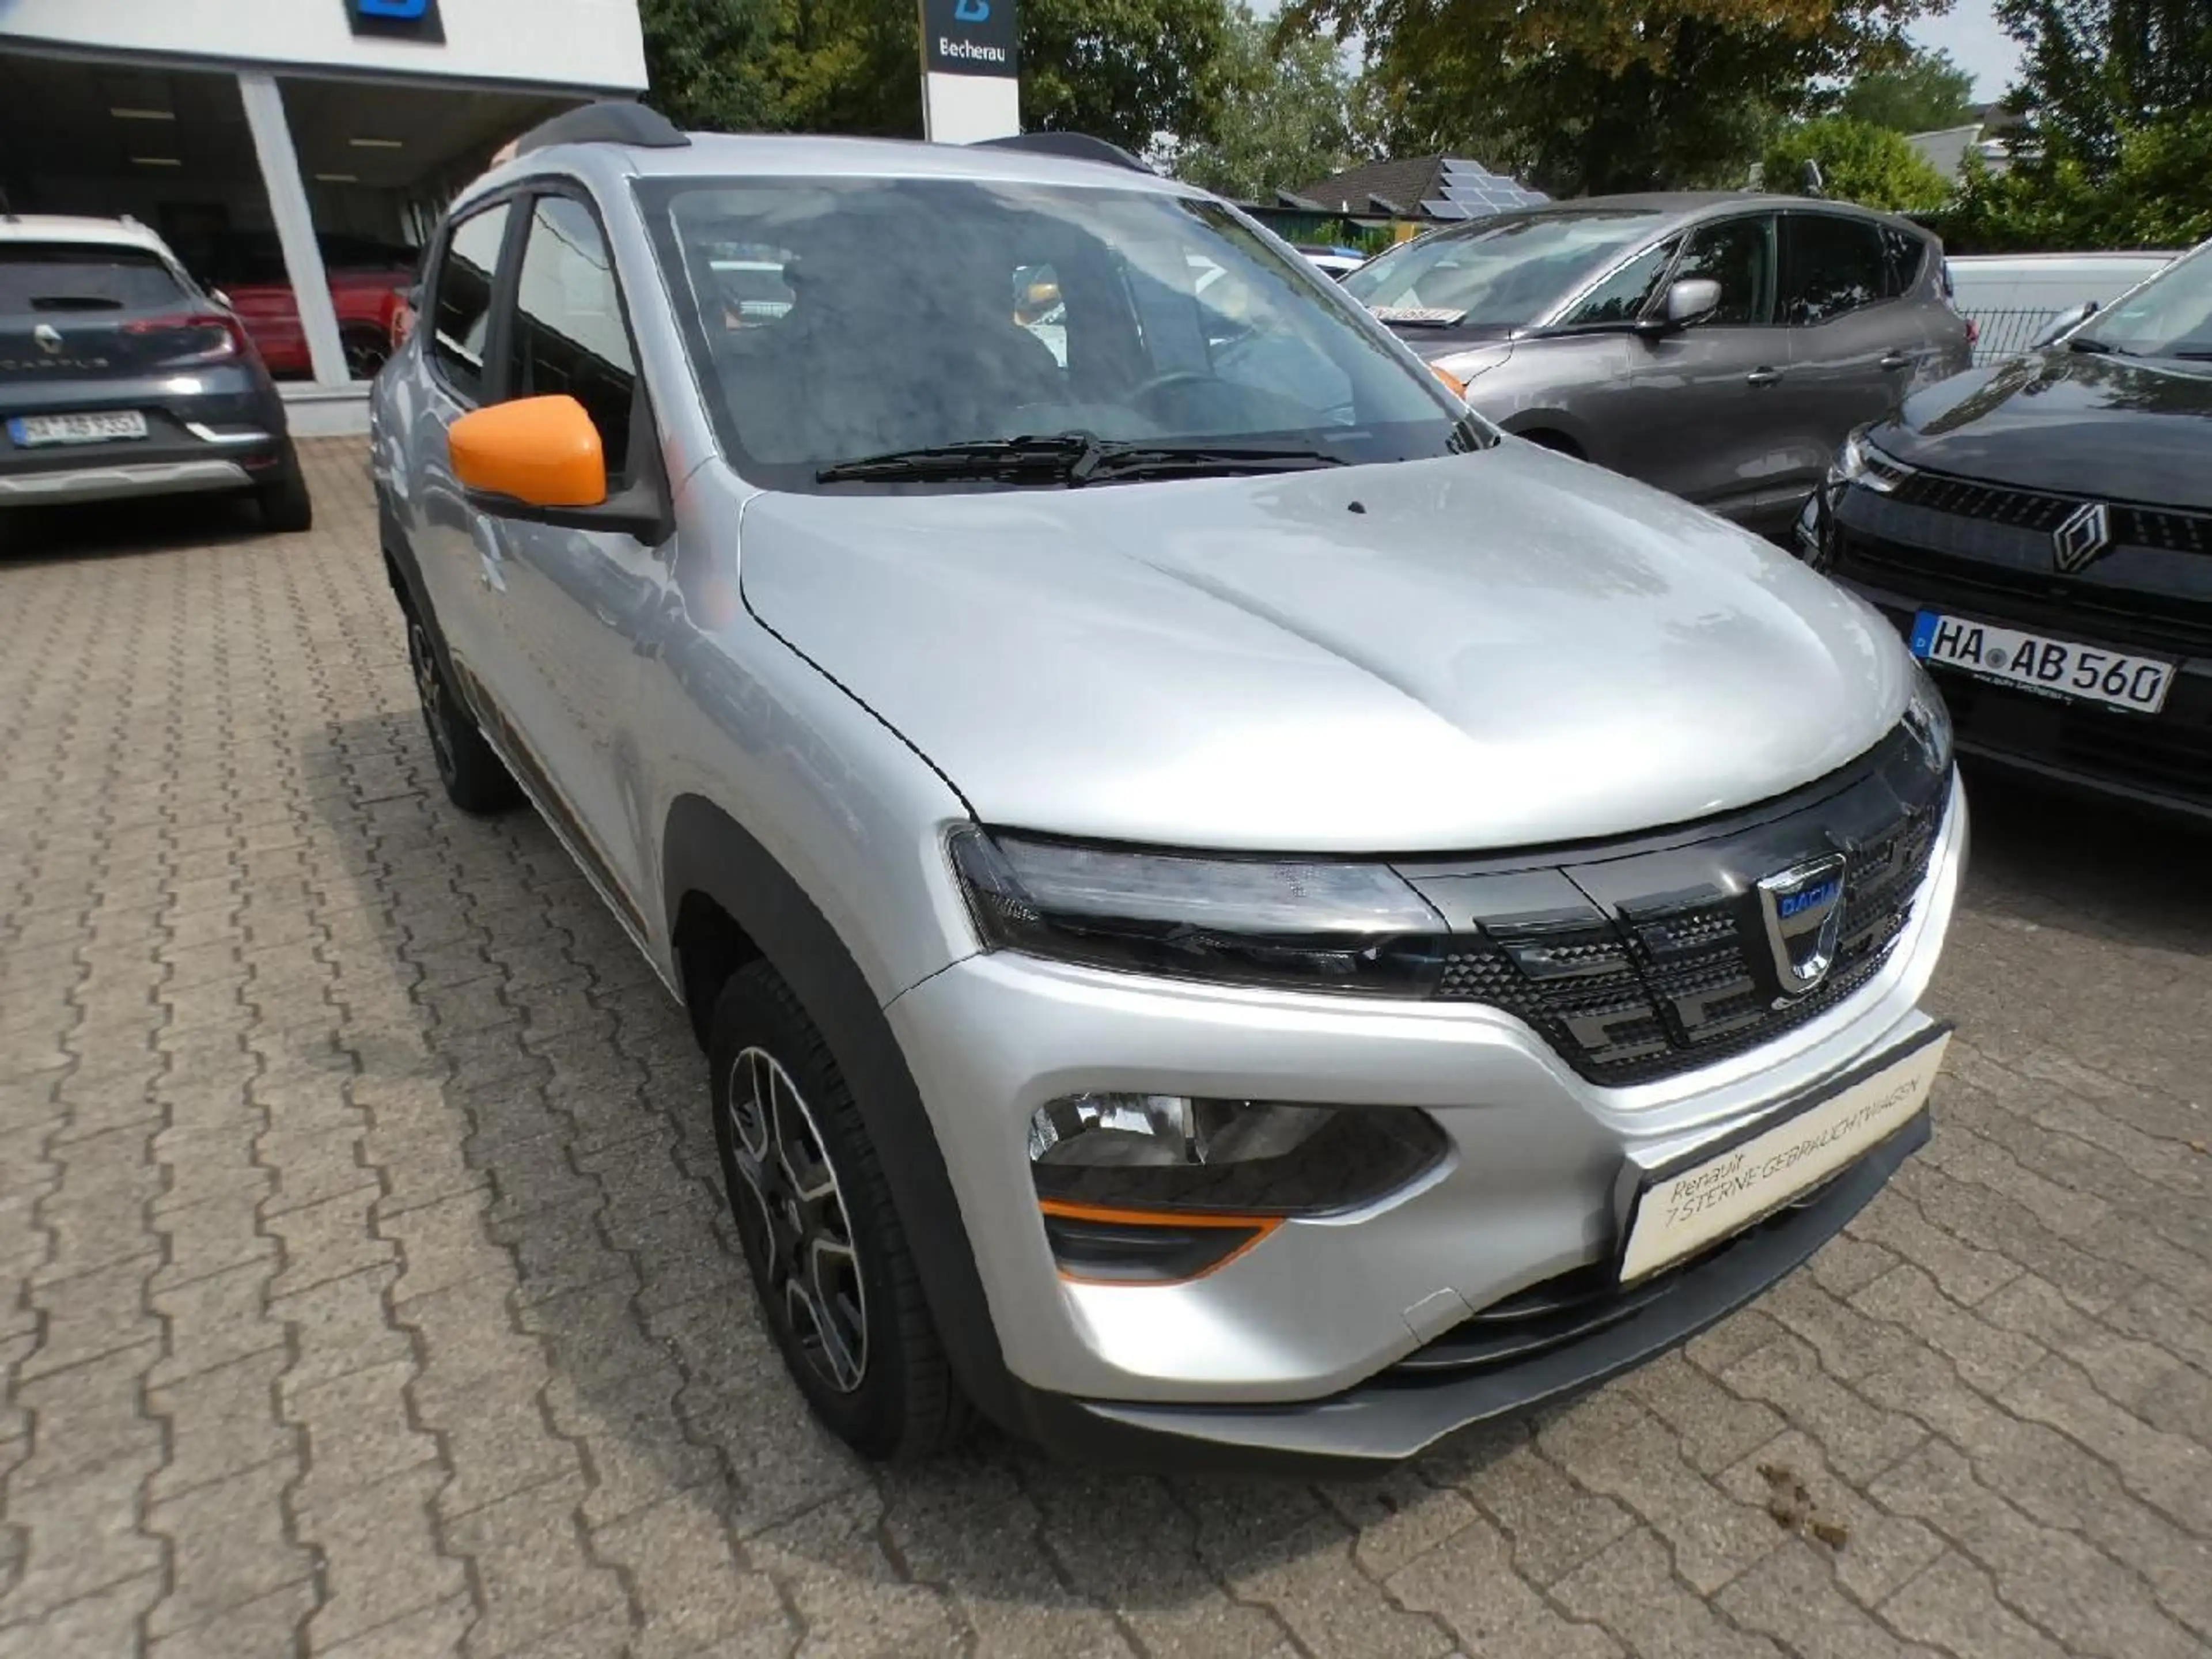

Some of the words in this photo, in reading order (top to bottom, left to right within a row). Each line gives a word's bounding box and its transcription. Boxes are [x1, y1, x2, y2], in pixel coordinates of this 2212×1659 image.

[940, 37, 1006, 62] Becherau
[1934, 621, 1983, 664] HA
[2010, 640, 2068, 681] AB
[2073, 653, 2162, 702] 560
[1782, 881, 1839, 917] DACIA
